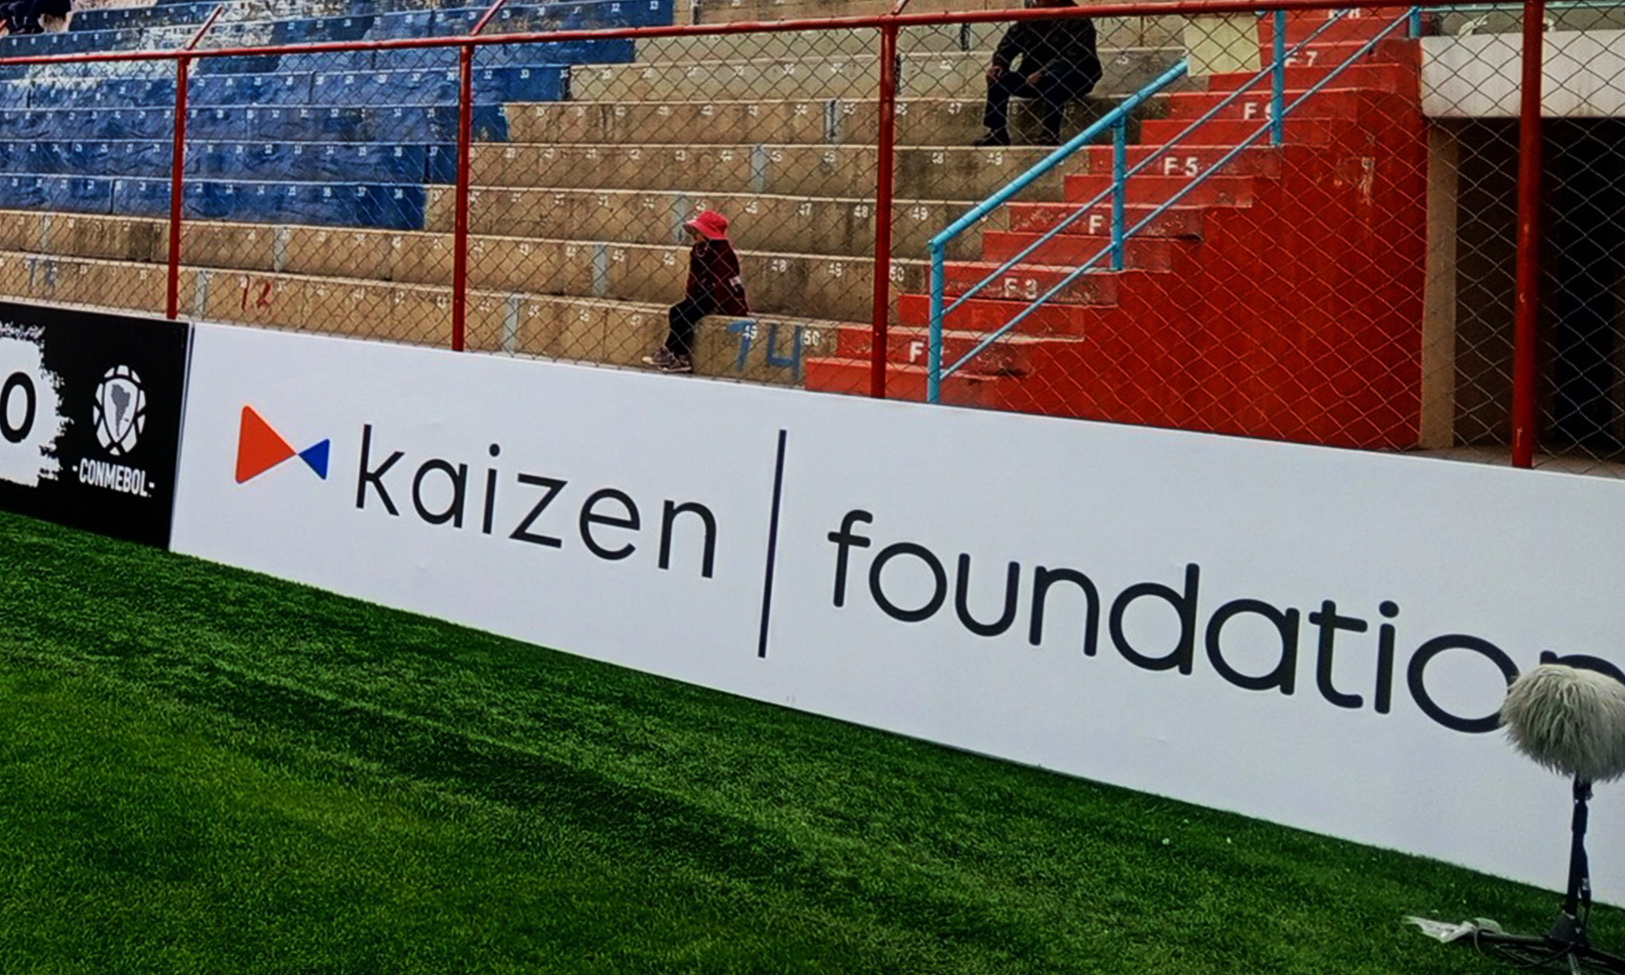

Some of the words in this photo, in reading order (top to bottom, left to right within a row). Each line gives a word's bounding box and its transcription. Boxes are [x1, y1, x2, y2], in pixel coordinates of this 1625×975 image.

[1305, 50, 1318, 68] 7
[1164, 157, 1177, 175] F
[1185, 156, 1199, 176] 5
[1089, 214, 1103, 235] F
[1004, 277, 1018, 298] F
[909, 341, 924, 363] F
[78, 457, 150, 497] CONMEBOL
[355, 422, 718, 580] kaizen
